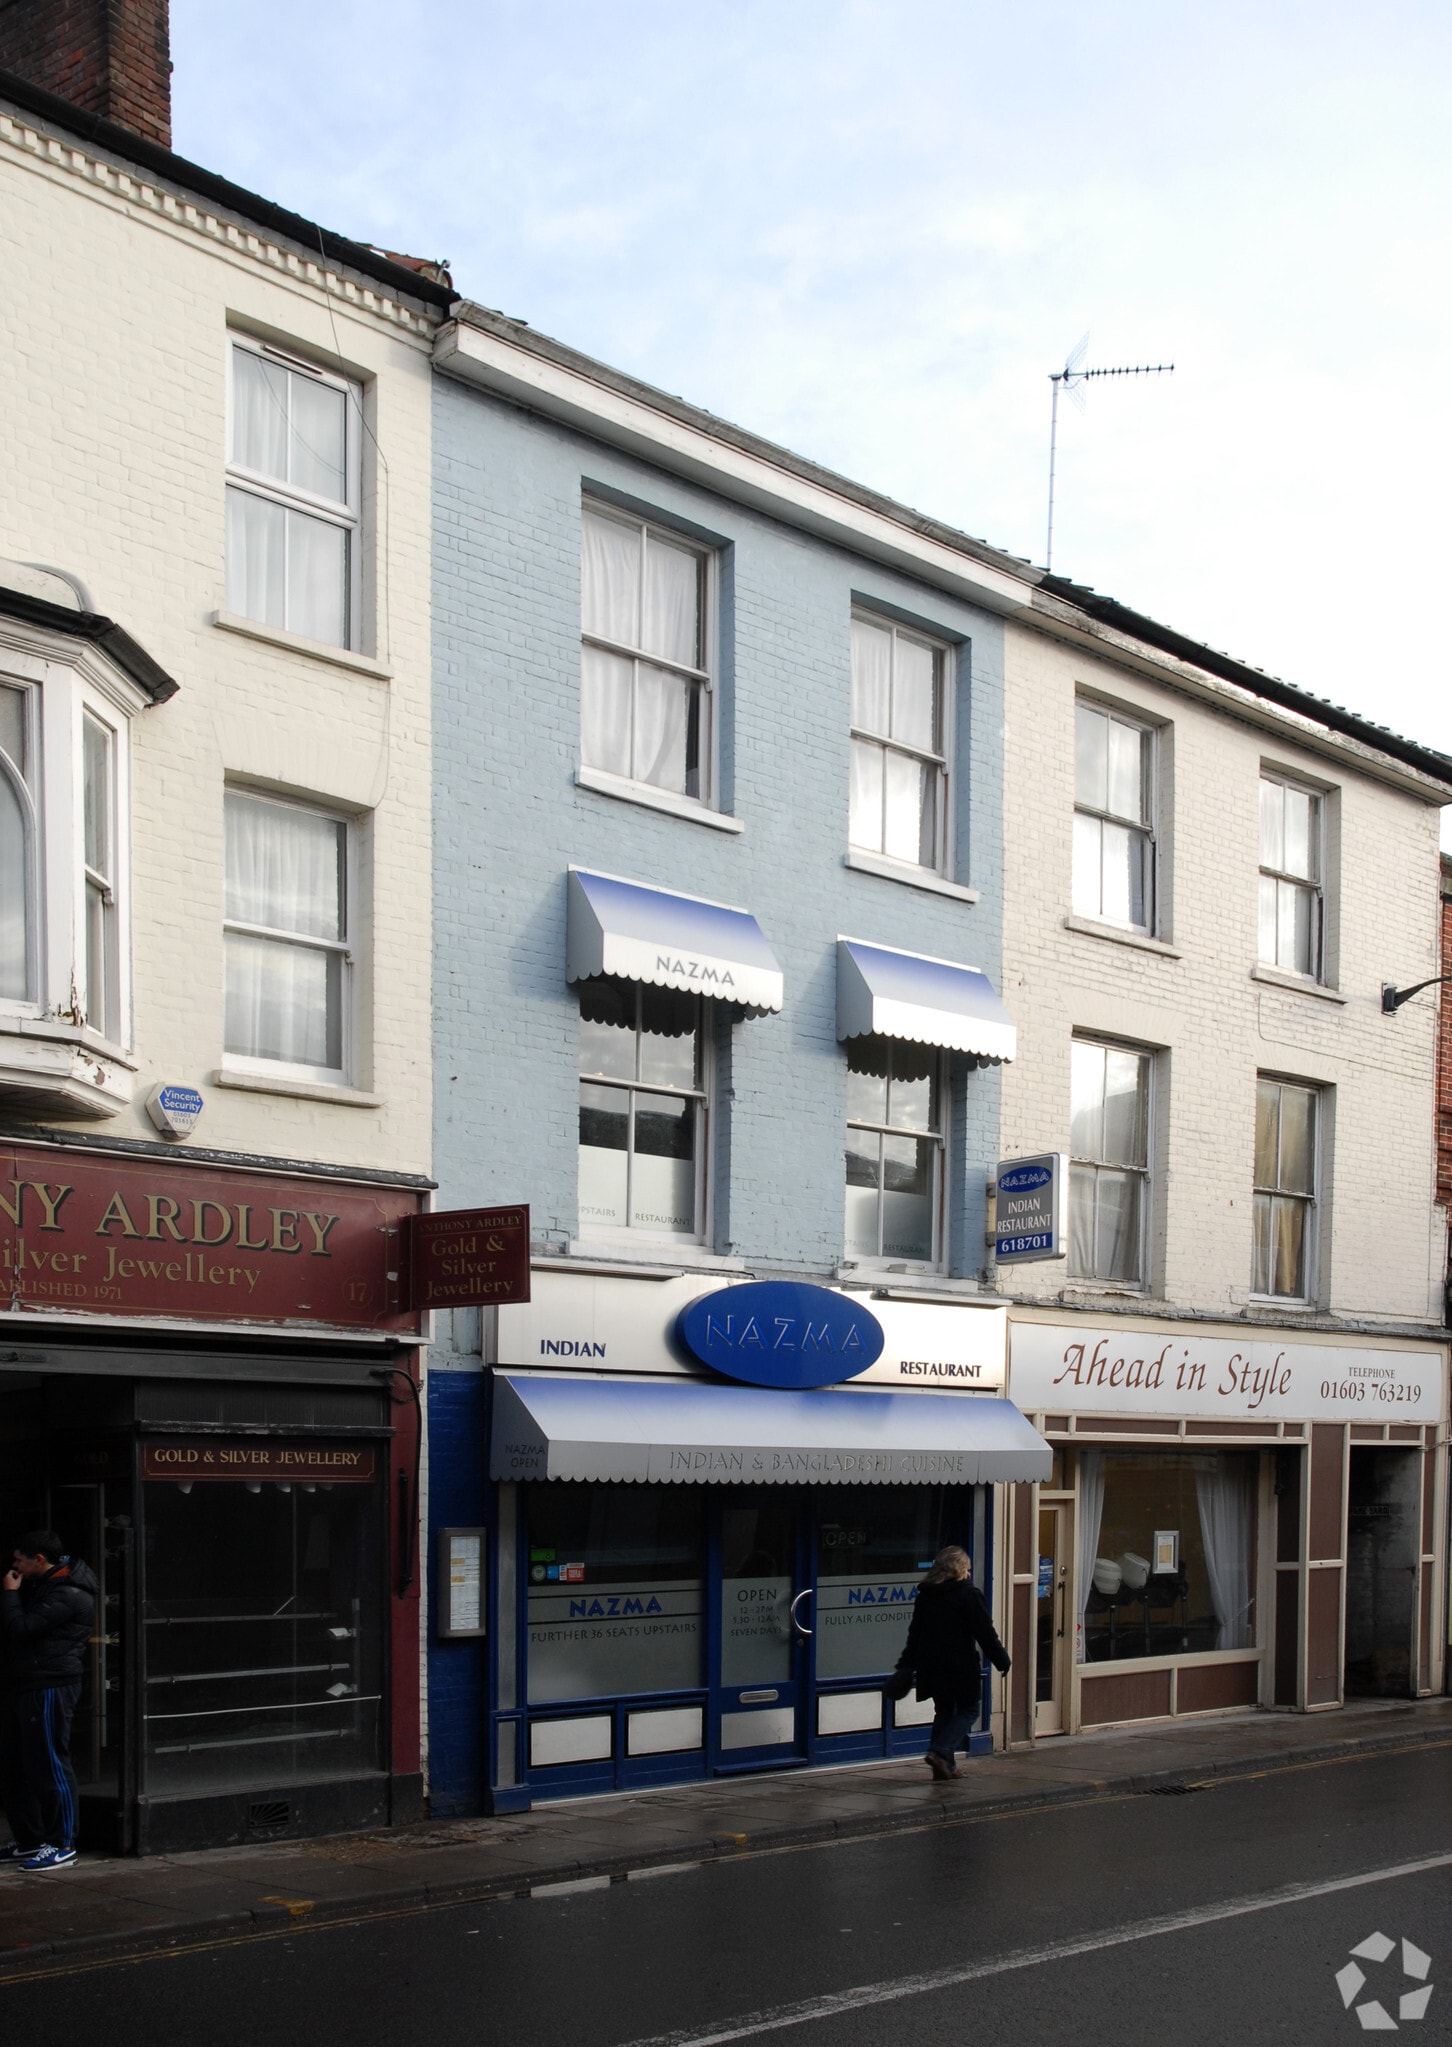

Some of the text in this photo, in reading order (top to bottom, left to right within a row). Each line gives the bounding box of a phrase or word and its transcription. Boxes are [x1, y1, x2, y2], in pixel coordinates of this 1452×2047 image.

[656, 955, 736, 987] NAZMA
[164, 1089, 200, 1103] Vincent
[164, 1098, 201, 1113] Security
[1000, 1171, 1049, 1188] NAZMA
[1008, 1198, 1041, 1214] INDIAN
[94, 1190, 340, 1257] ARDLEY
[417, 1215, 522, 1233] ANTHONY ARDLEY
[997, 1213, 1052, 1233] RESTAURANT
[432, 1235, 506, 1256] Gold &
[1001, 1235, 1047, 1252] 618701
[103, 1246, 262, 1294] Jewellery
[441, 1258, 497, 1276] Silver
[93, 1285, 122, 1300] 1971
[347, 1282, 368, 1302] 17
[426, 1277, 514, 1301] Jewellery
[705, 1314, 868, 1355] NAZMA
[540, 1339, 606, 1358] INDIAN
[900, 1361, 982, 1378] RESTAURANT
[1053, 1338, 1292, 1409] Ahead in Style
[1348, 1366, 1396, 1379] TELEPHONE
[1320, 1379, 1422, 1405] 01603 763219
[154, 1449, 362, 1466] GOLD & SILVER JEWELLERY
[505, 1444, 545, 1455] NAZMA
[511, 1457, 539, 1468] OPEN
[669, 1450, 965, 1473] INDIAN & BANGLADESHI CUISINE
[825, 1531, 866, 1546] OPEN
[737, 1589, 777, 1602] OPEN
[848, 1585, 920, 1605] NAZMA
[569, 1595, 662, 1618] NAZMA
[740, 1606, 748, 1614] 12
[755, 1605, 774, 1614] 2PM
[825, 1614, 853, 1626] FULLY
[855, 1614, 872, 1624] AIR
[531, 1623, 697, 1643] FURTHER 36 SEATS UPSTAIRS
[730, 1626, 782, 1637] SEVEN DAYS
